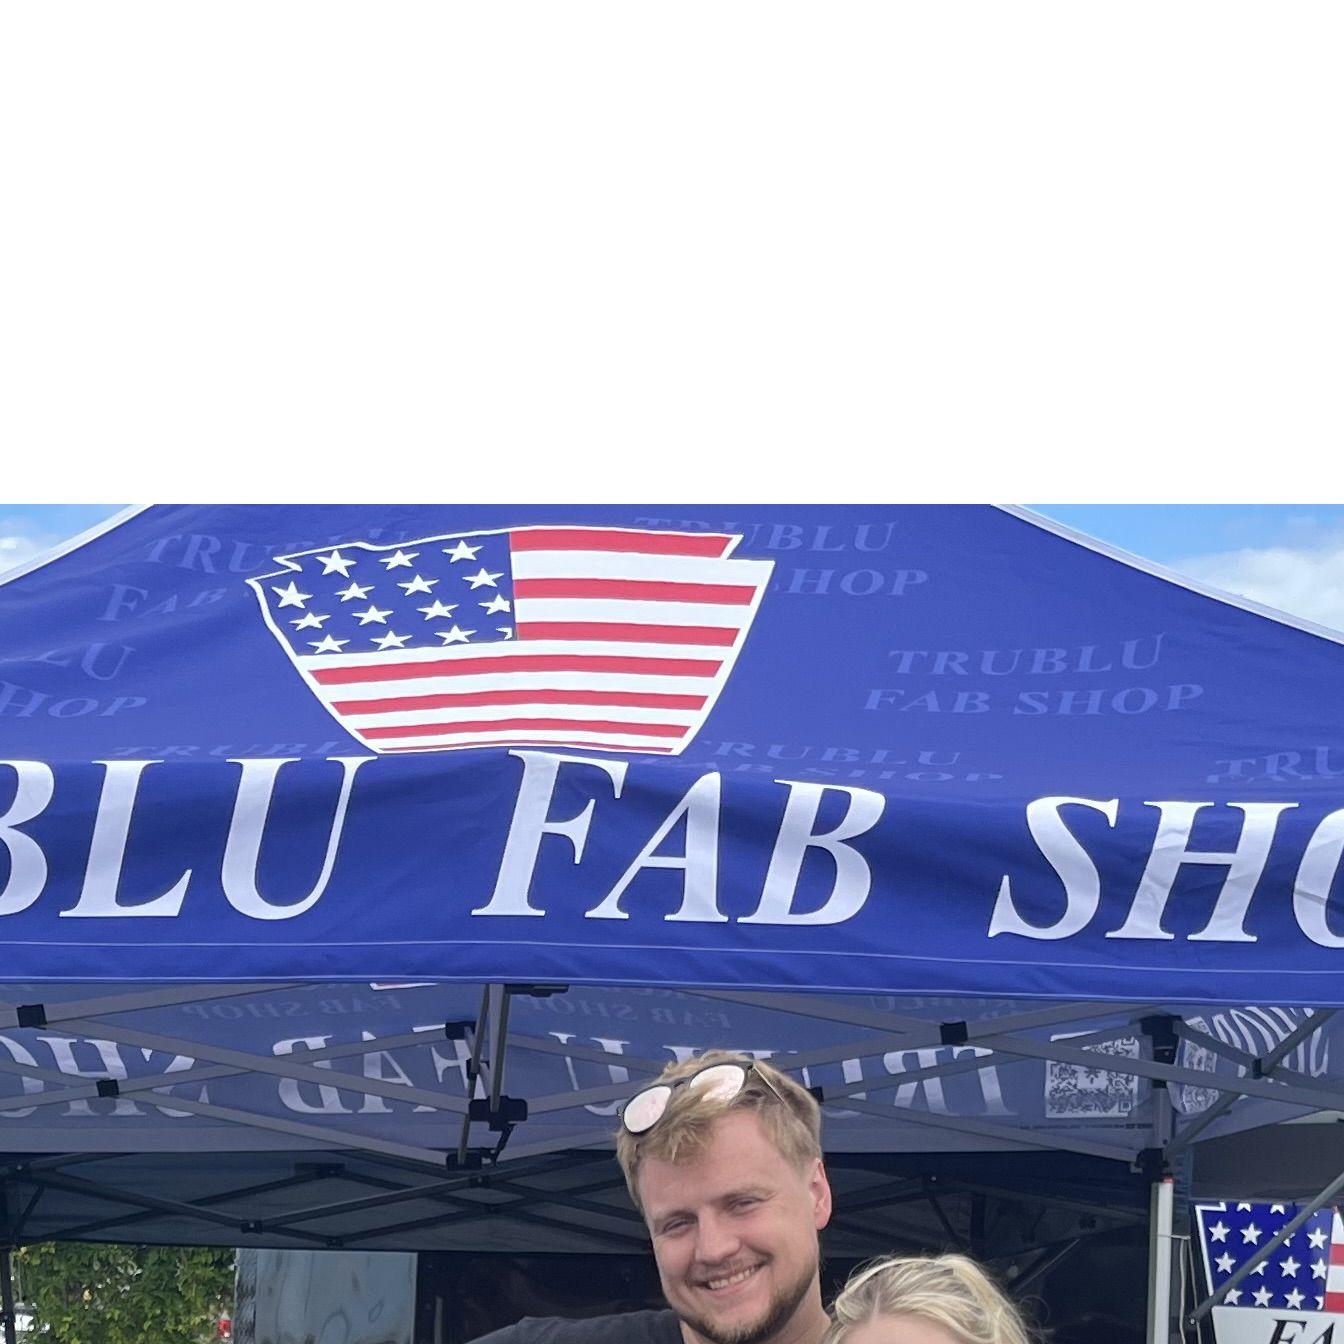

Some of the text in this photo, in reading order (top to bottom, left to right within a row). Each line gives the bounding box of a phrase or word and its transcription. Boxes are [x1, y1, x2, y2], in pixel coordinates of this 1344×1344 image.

[774, 568, 928, 596] HOP
[888, 632, 1166, 676] TRUBLU
[864, 684, 1204, 715] FAB SHOP
[712, 741, 961, 766] RUBLU
[471, 750, 886, 926] FAB
